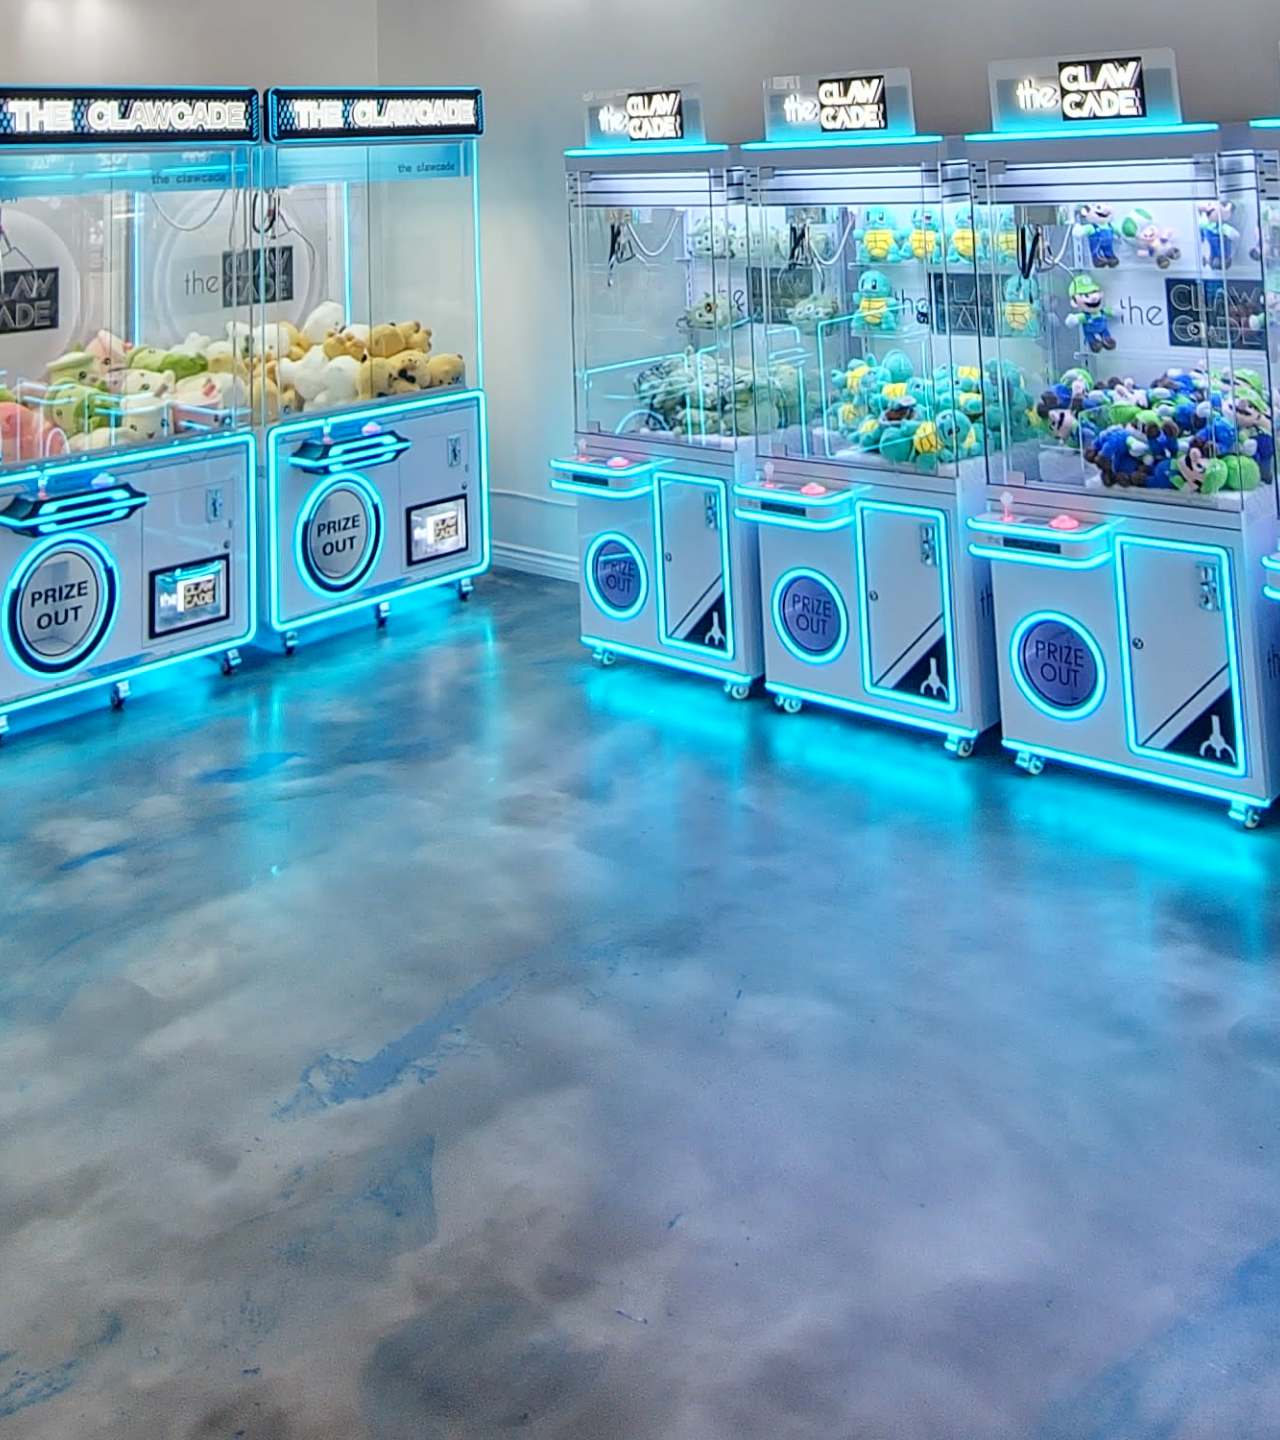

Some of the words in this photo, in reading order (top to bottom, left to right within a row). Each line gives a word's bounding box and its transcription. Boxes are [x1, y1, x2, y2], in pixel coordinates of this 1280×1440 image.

[1060, 61, 1139, 91] CLAW
[626, 93, 679, 117] CLAW
[819, 78, 882, 106] CLAW
[1017, 77, 1059, 111] the
[1062, 89, 1139, 118] CADE
[7, 101, 73, 133] THE
[86, 101, 247, 132] CLAWCADE
[292, 100, 343, 128] THE
[350, 99, 477, 126] CLAWCADE
[784, 93, 819, 122] the
[820, 104, 883, 129] CADE
[628, 115, 680, 139] CADE
[152, 172, 169, 184] the
[185, 270, 219, 296] the
[1120, 296, 1165, 326] the
[1170, 284, 1258, 312] CLAW
[317, 513, 361, 537] PRIZE
[322, 534, 357, 557] OUT
[30, 580, 88, 609] PRIZE
[606, 573, 634, 594] OUT
[37, 604, 82, 630] OUT
[792, 593, 833, 618] PRIZE
[796, 614, 829, 637] OUT
[1034, 639, 1086, 668] PRIZE
[1040, 661, 1081, 688] OUT
